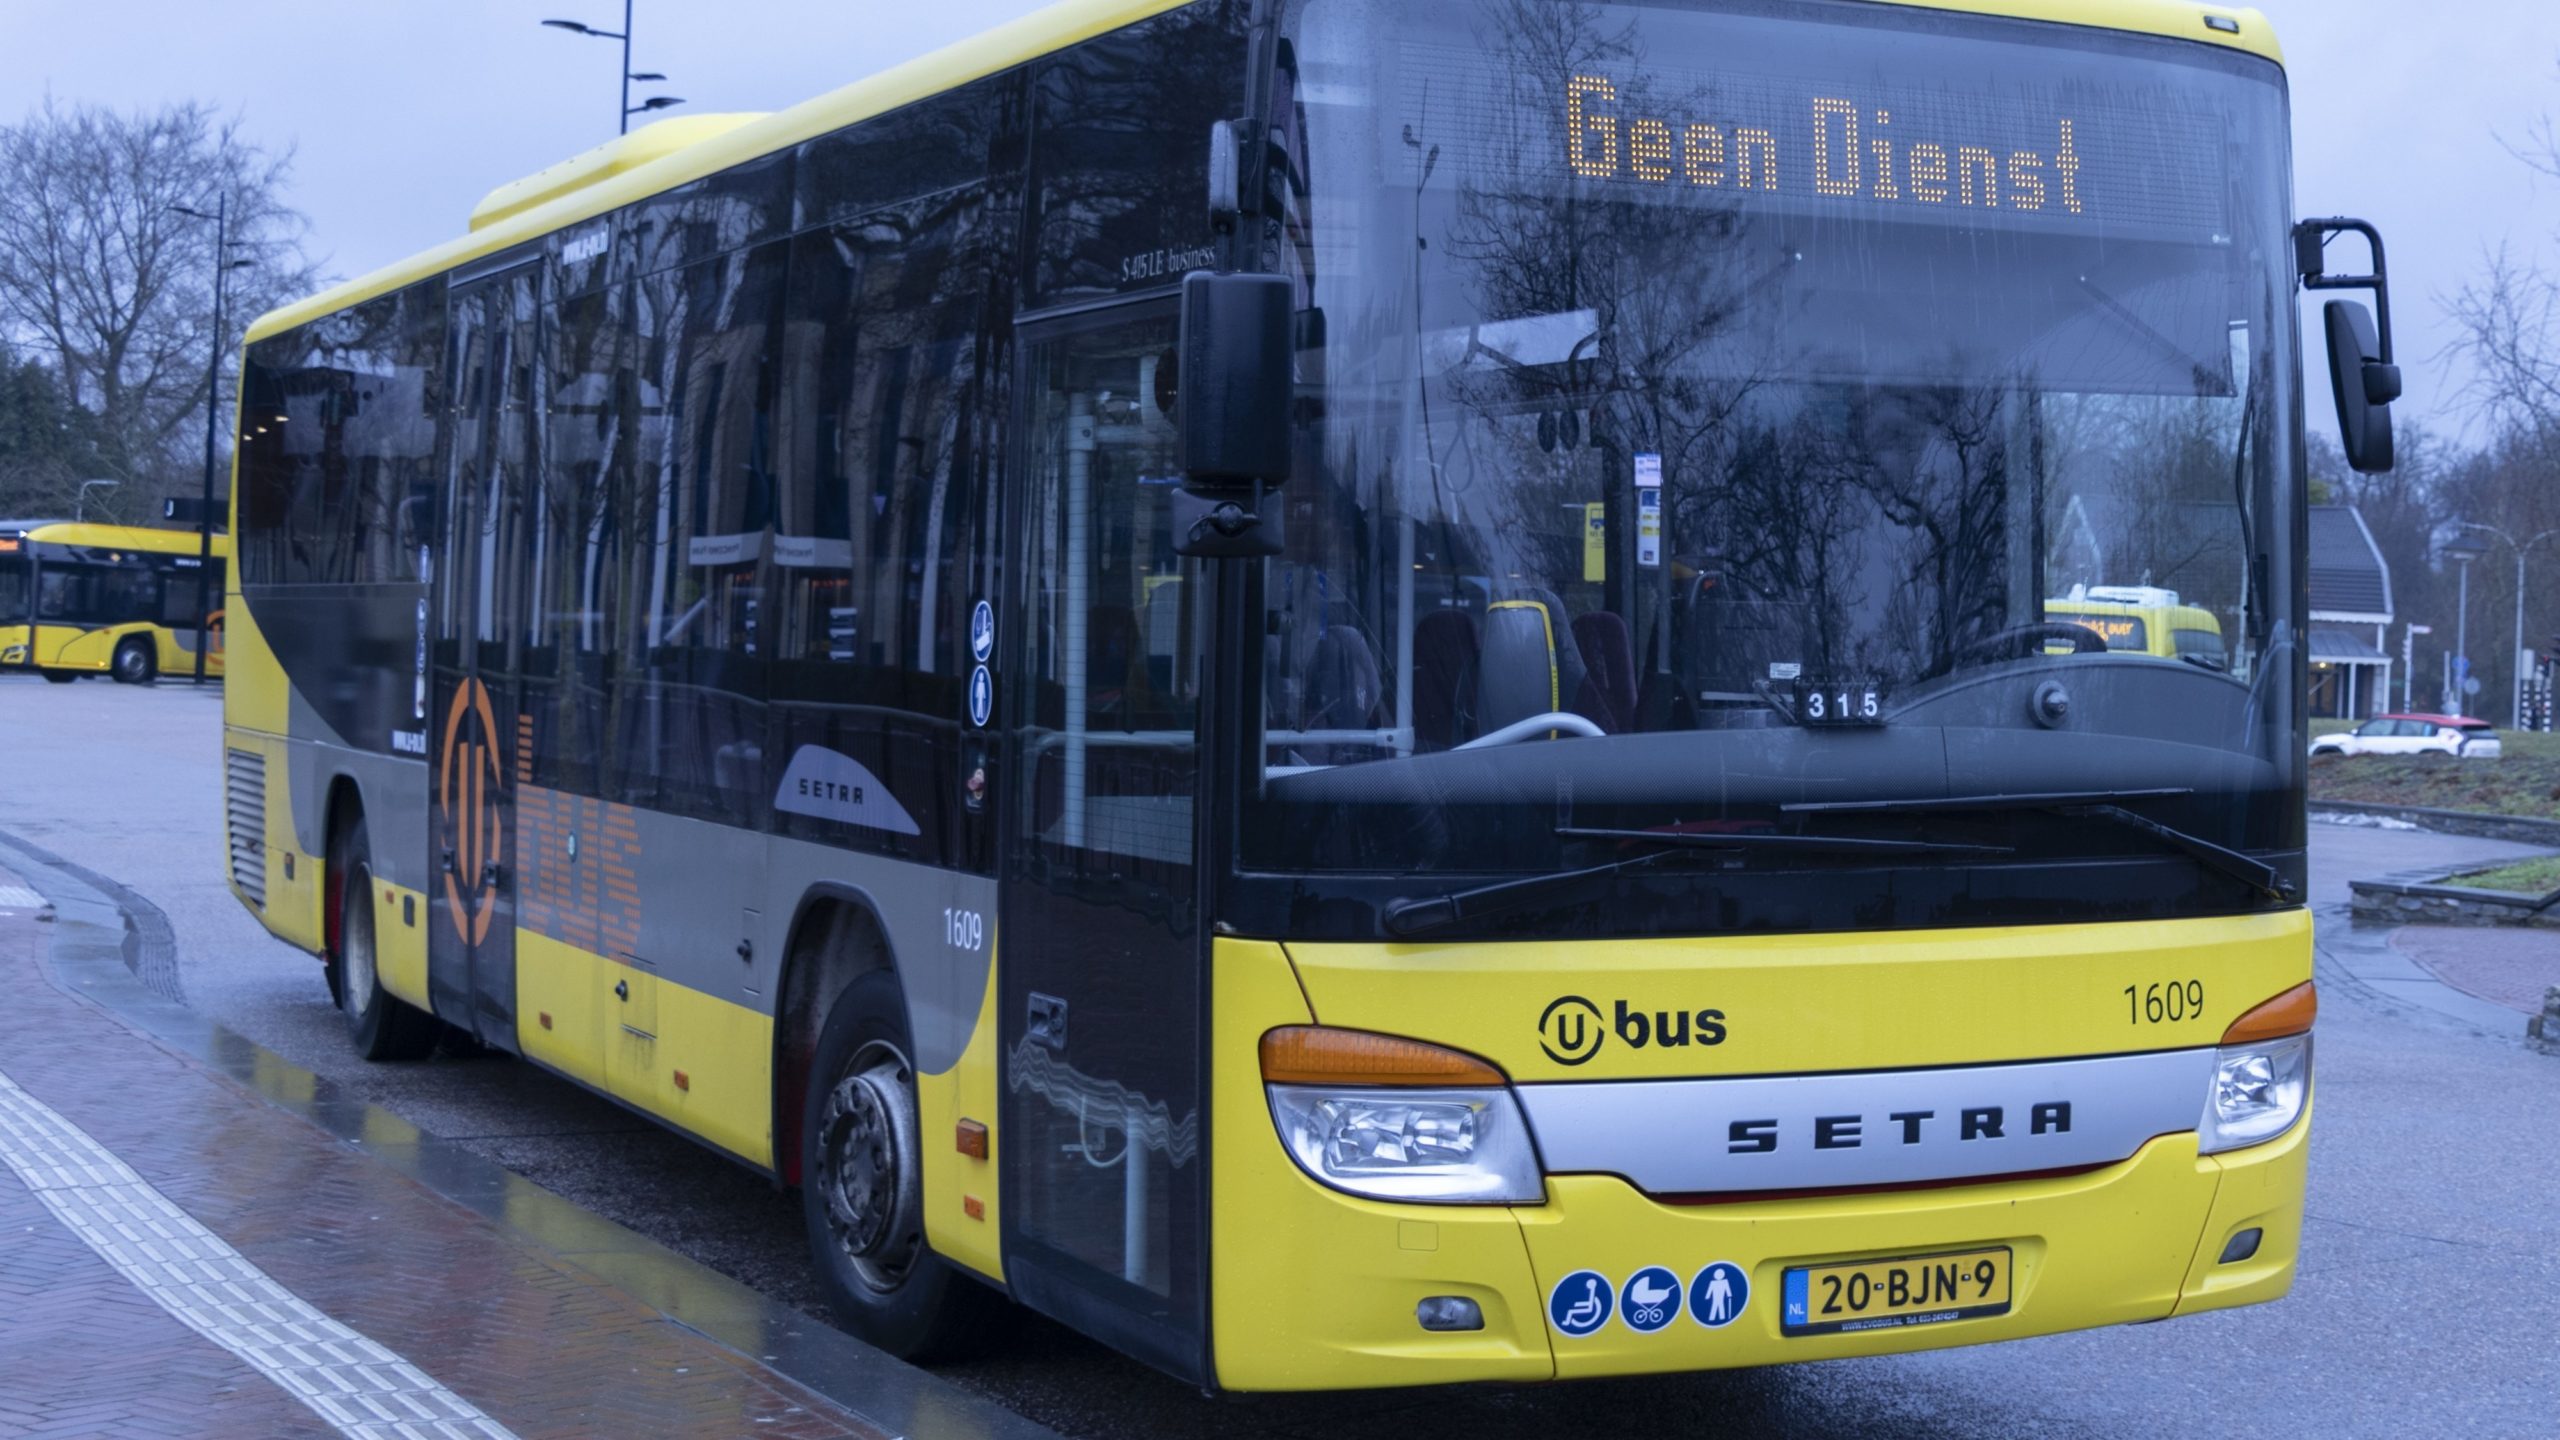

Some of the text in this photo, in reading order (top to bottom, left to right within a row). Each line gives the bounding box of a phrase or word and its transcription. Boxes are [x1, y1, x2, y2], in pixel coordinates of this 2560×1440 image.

[1569, 76, 2081, 213] Geen Dienst
[1122, 244, 1216, 282] S 415 LE business
[799, 777, 864, 805] SETRA
[944, 906, 983, 951] 1609
[1614, 999, 1728, 1049] bus
[2123, 979, 2204, 1025] 1609
[1728, 1100, 2072, 1154] SETRA
[1789, 1302, 1806, 1316] NL
[1821, 1259, 1996, 1315] 20-BJN-9
